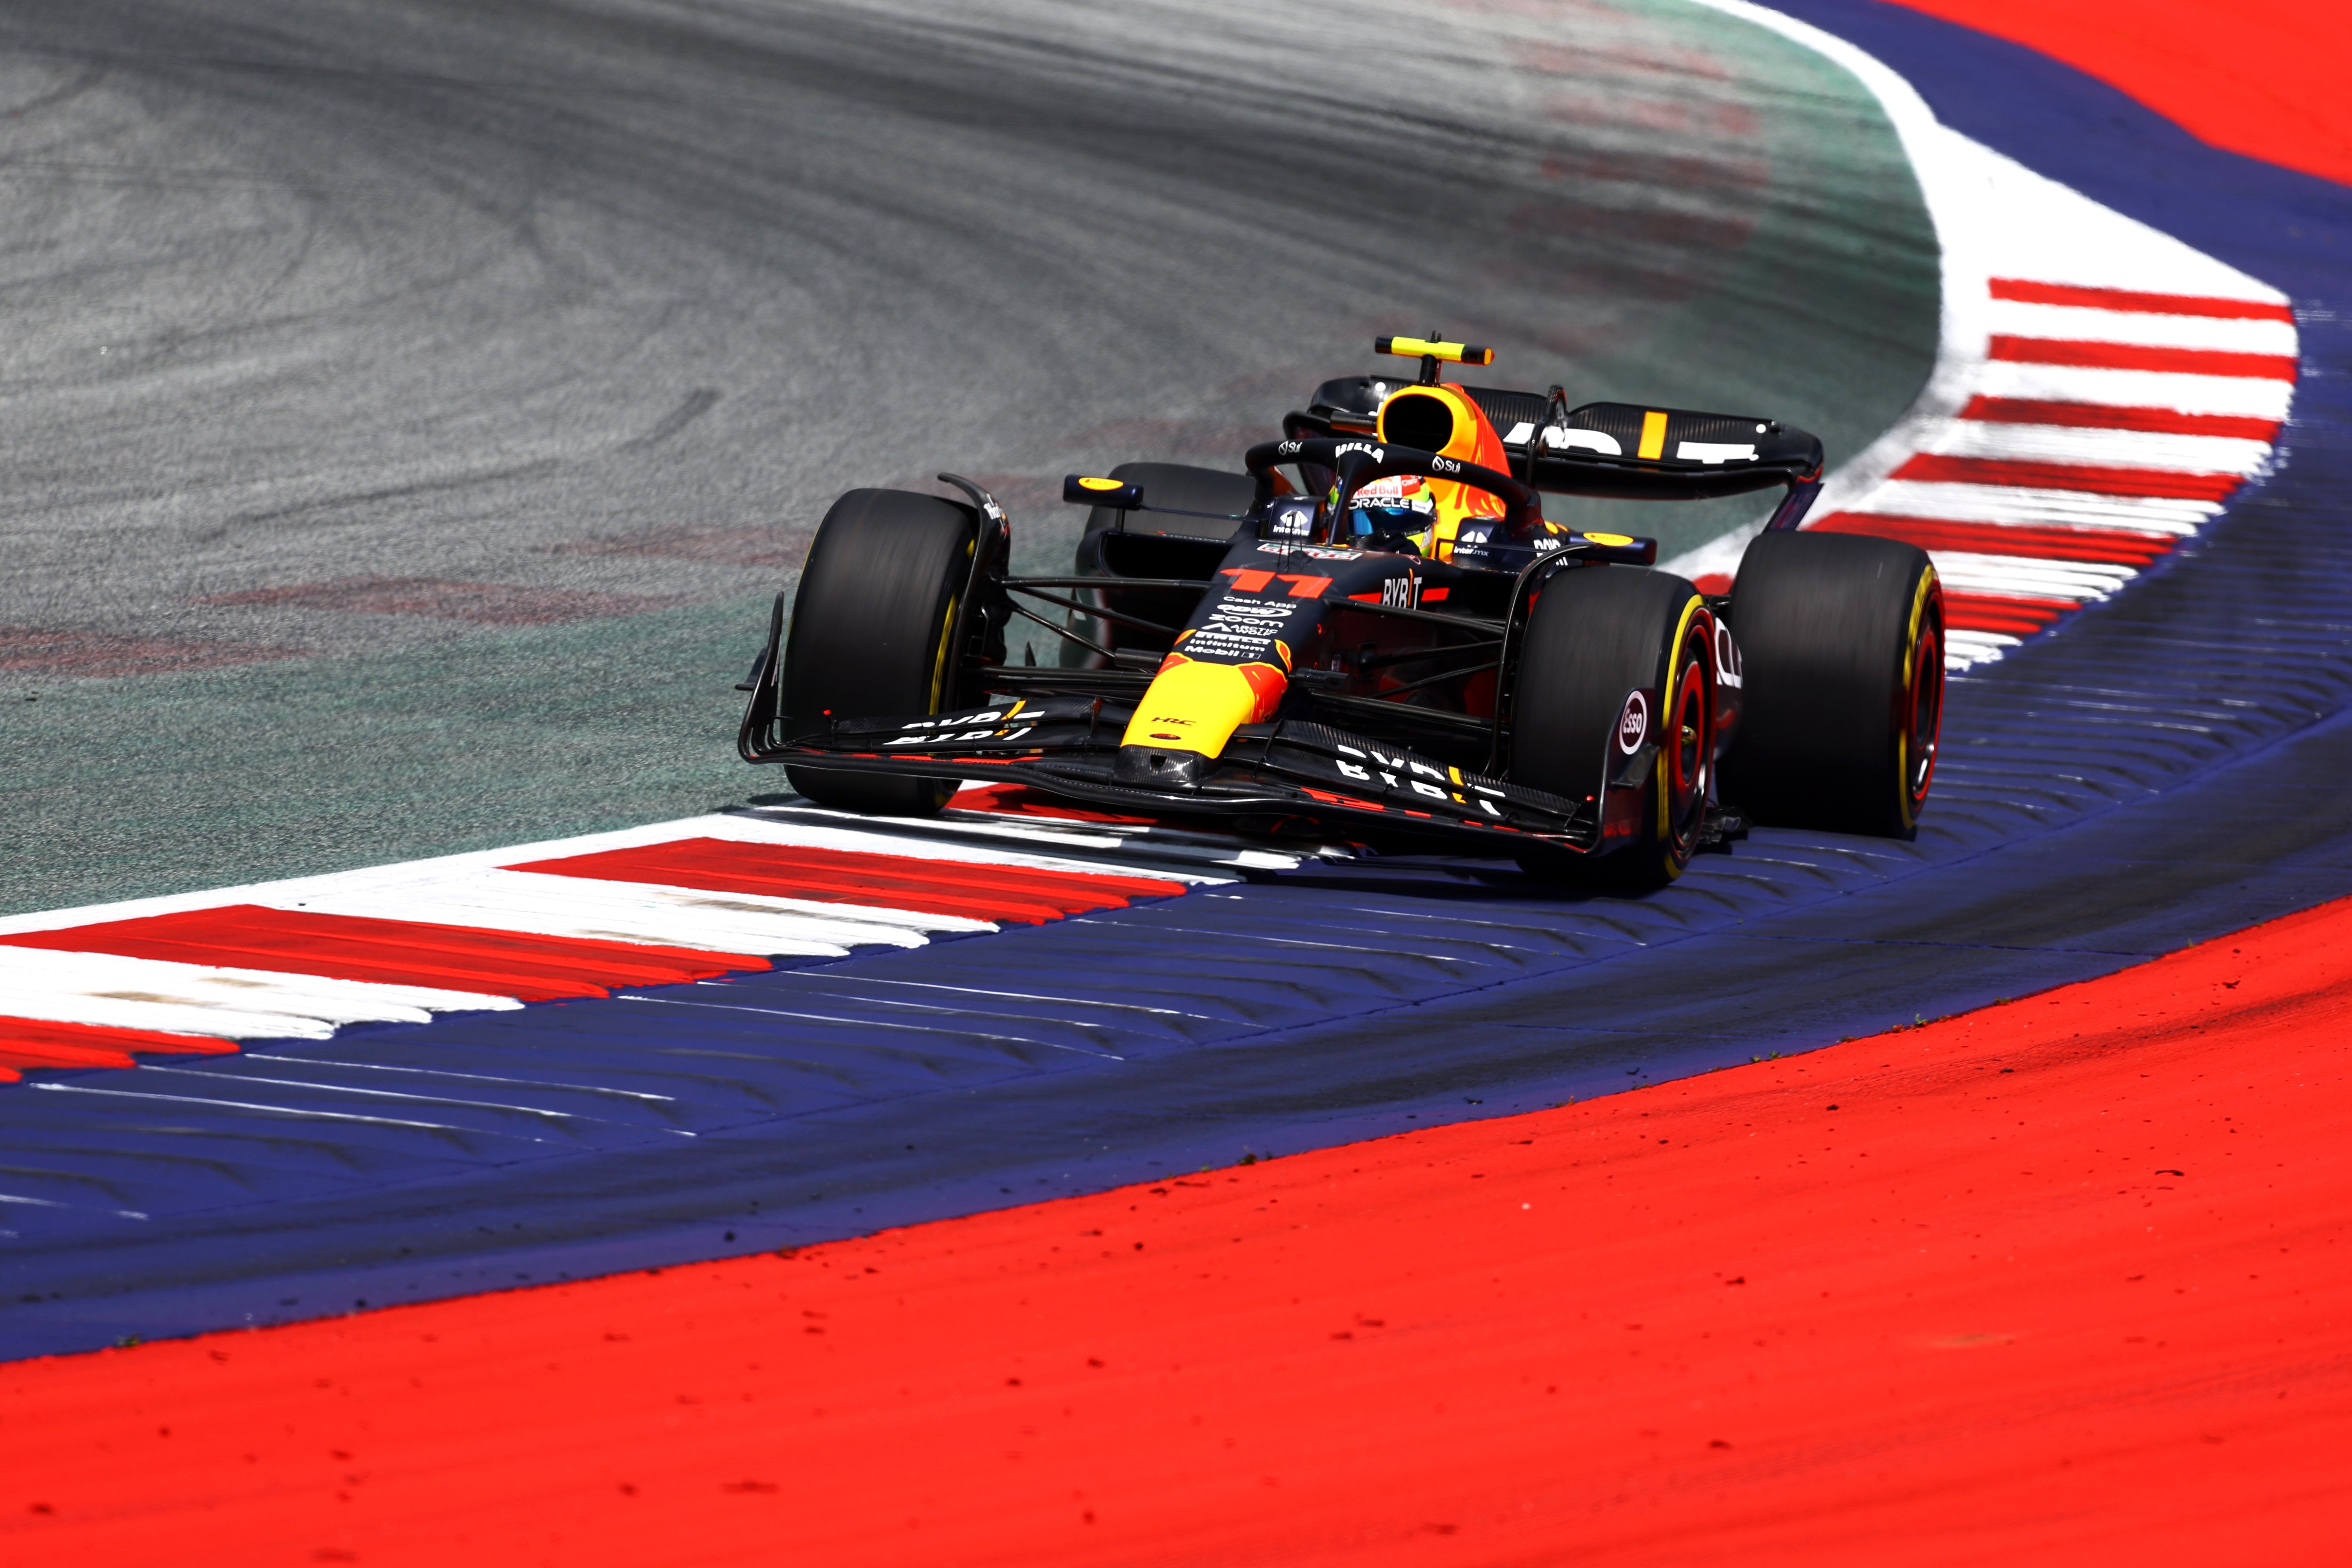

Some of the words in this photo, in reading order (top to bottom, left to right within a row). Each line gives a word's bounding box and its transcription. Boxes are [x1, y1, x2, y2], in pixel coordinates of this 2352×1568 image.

[1445, 460, 1461, 474] Sui
[1357, 486, 1377, 496] Red
[1378, 485, 1399, 495] Bull
[1348, 497, 1410, 510] ORACLE
[1454, 546, 1489, 557] inter.mx
[1220, 568, 1333, 599] 11
[1382, 568, 1423, 611] BYBIT
[1223, 596, 1261, 605] Cash
[1264, 601, 1297, 609] App
[1230, 624, 1279, 634] ARCTIC
[1235, 628, 1272, 637] WOLF
[1184, 645, 1240, 657] Mobil
[1151, 717, 1196, 726] HRC
